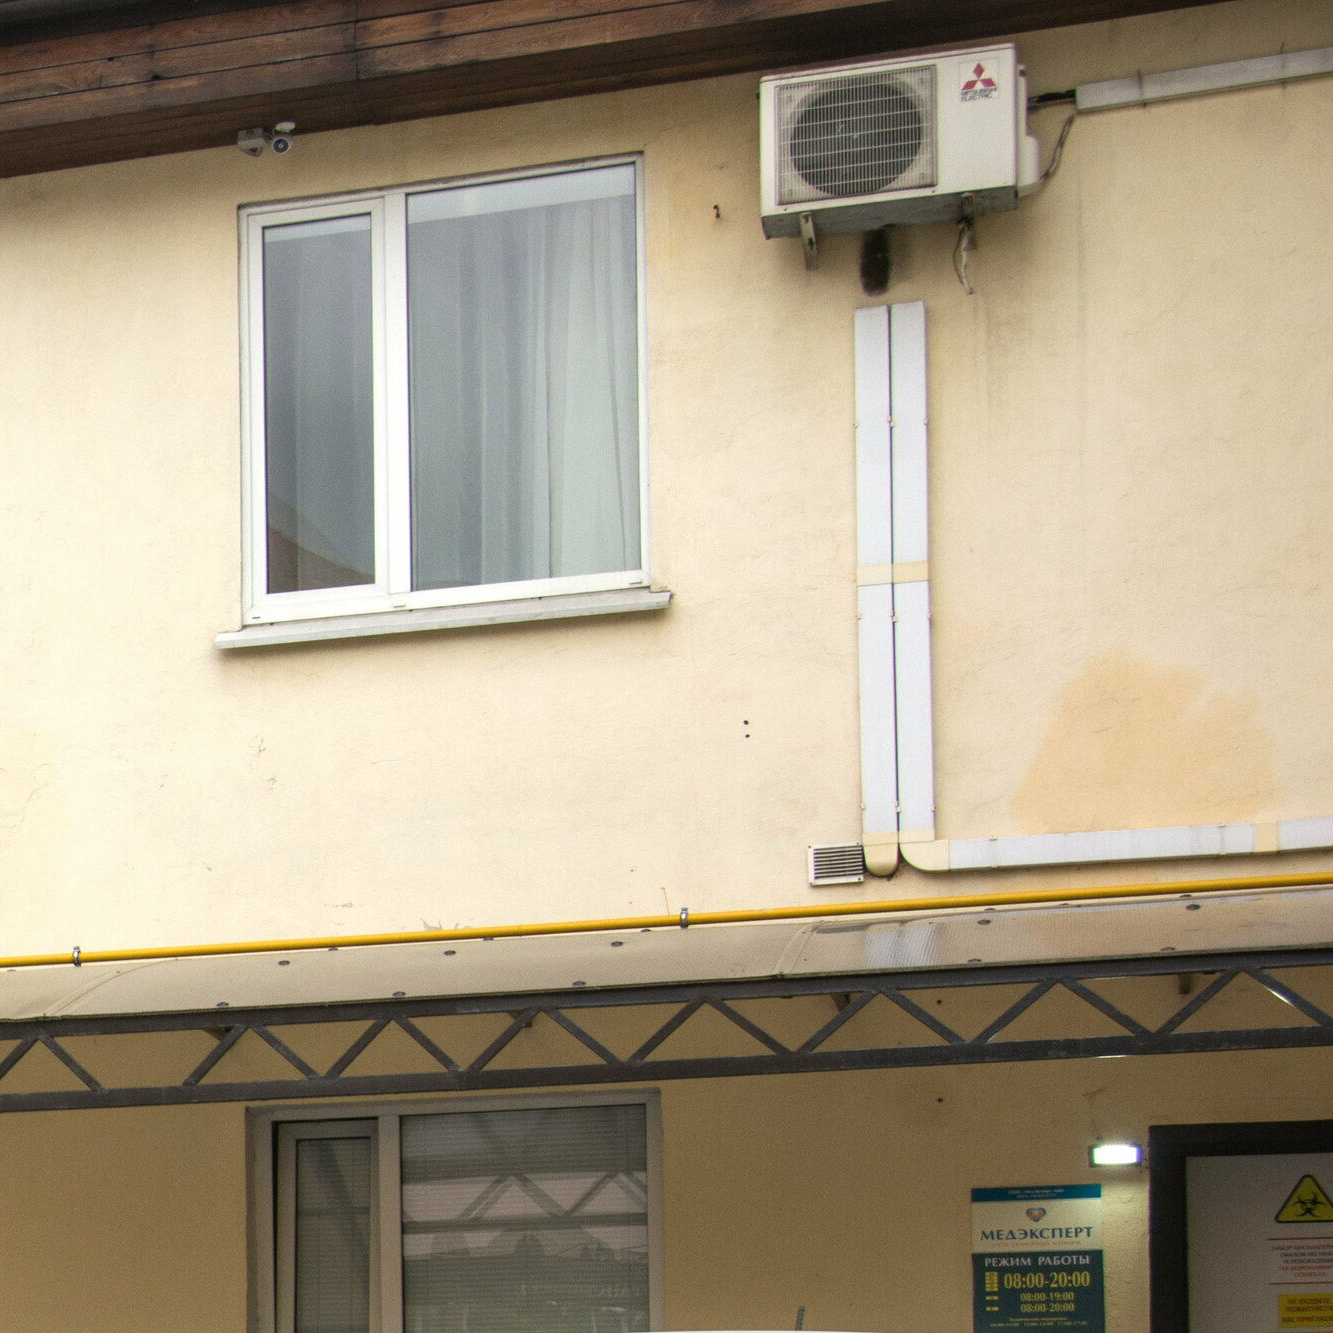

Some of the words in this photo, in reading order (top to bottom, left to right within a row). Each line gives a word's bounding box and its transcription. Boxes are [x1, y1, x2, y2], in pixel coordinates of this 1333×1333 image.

[980, 1227, 1093, 1241] МЕДЭКСПЕРТ
[985, 1257, 1031, 1267] РЕЖИМ
[1038, 1255, 1090, 1266] РАБОТЫ
[1004, 1271, 1090, 1288] 08:00-20:00
[1020, 1292, 1075, 1302] 08:00-19:00
[1020, 1303, 1075, 1312] 08:00-20:00
